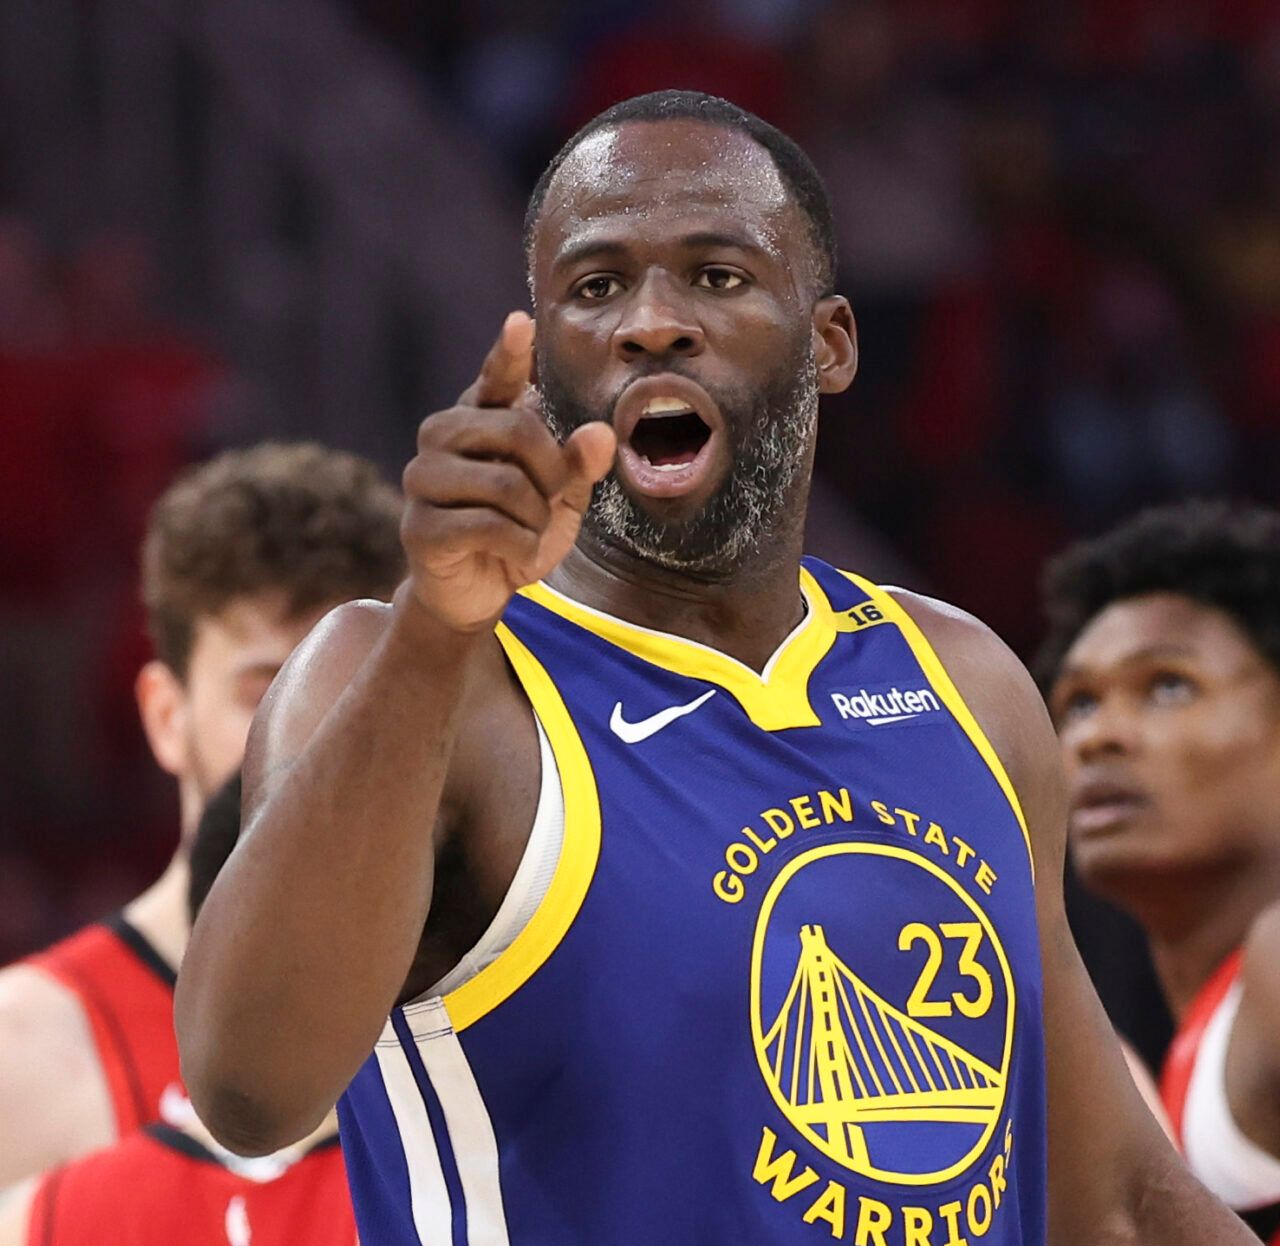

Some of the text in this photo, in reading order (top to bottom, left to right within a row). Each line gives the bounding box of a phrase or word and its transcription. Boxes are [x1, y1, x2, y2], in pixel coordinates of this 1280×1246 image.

[847, 604, 883, 628] 16
[831, 687, 940, 720] Rakuten
[712, 788, 999, 904] GOLDEN STATE
[898, 922, 994, 1019] 23
